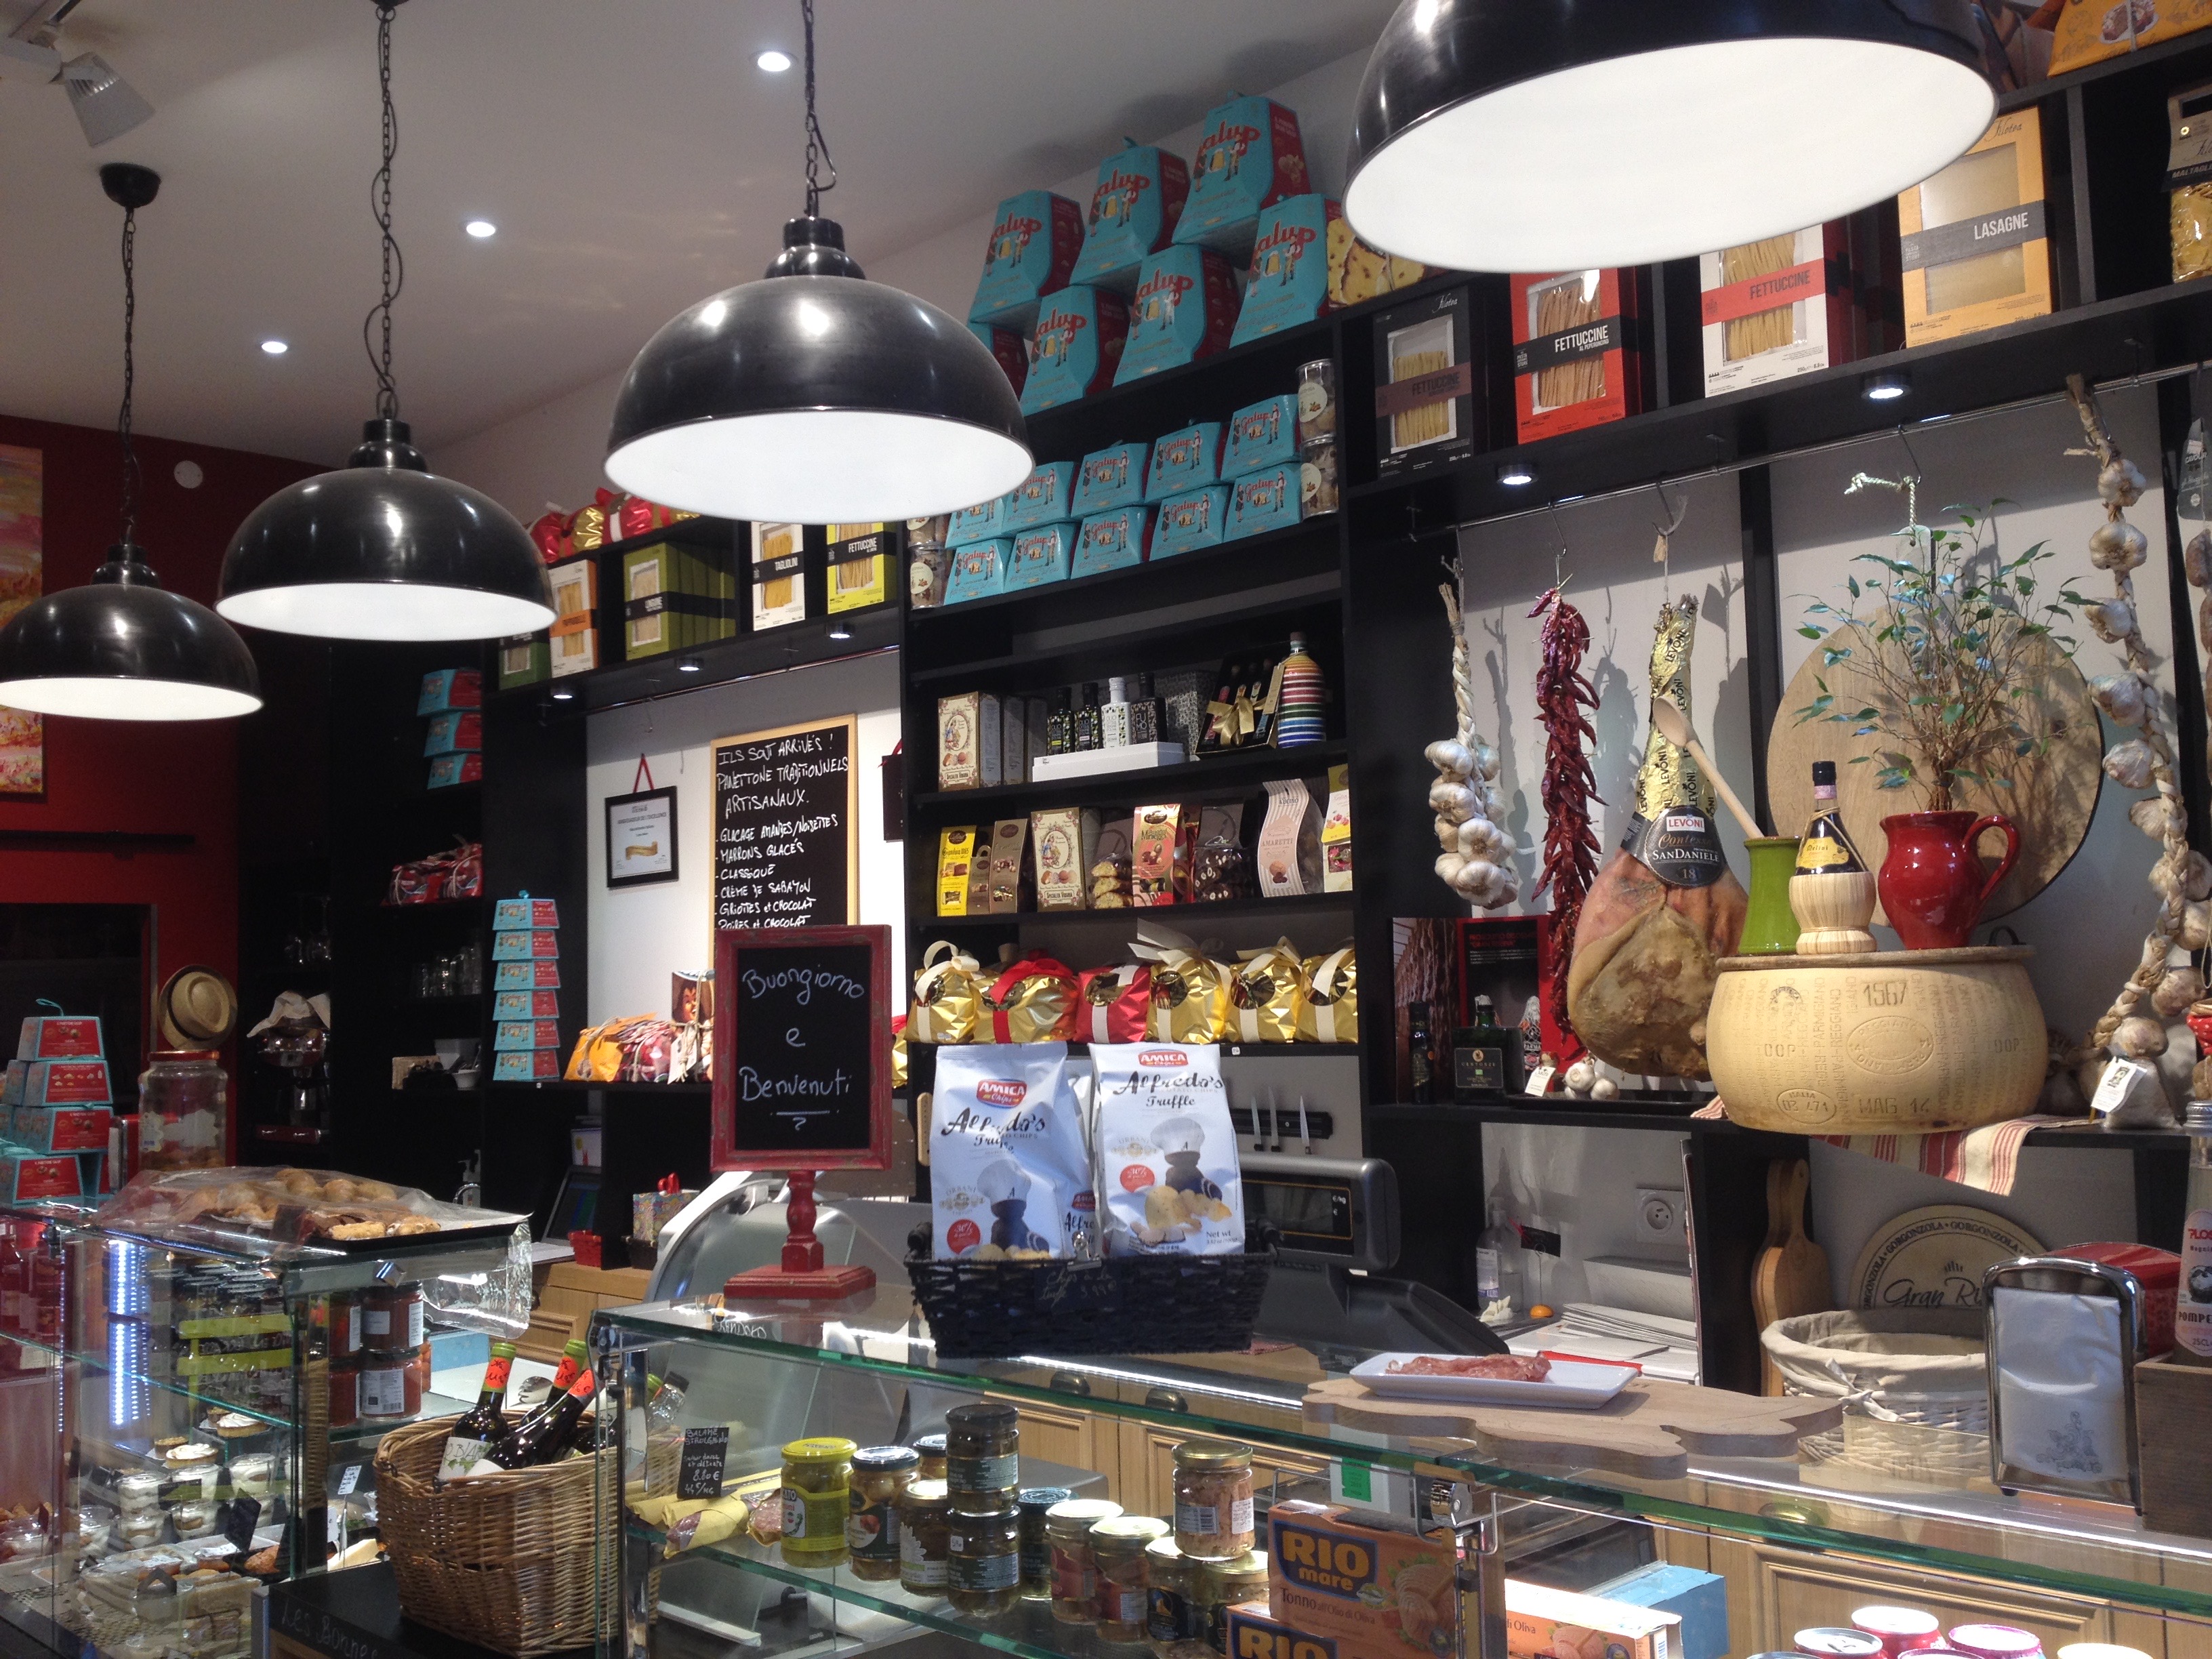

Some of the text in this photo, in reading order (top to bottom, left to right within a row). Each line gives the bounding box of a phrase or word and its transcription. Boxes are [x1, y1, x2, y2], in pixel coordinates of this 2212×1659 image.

[1974, 211, 2028, 240] LASAGNE
[1750, 270, 1810, 300] FETTUCCINE
[1555, 325, 1609, 352] FETTUCCINE
[1412, 371, 1460, 396] FETTUCCINE
[1665, 630, 1687, 662] LEVONI
[1677, 678, 1687, 711] LEVONI
[718, 750, 745, 765] ILS
[1658, 750, 1670, 785] LEVONI
[1639, 779, 1647, 813] LEVONI
[1688, 771, 1697, 806] LEVONI
[1668, 819, 1703, 828] LEVONI
[1261, 838, 1294, 847] AMARETTI
[720, 846, 762, 864] MARRONS
[720, 864, 776, 880] CLASSIQUE
[1682, 868, 1697, 879] 18
[752, 884, 763, 898] DE
[769, 878, 811, 895] SABAYON
[764, 903, 772, 913] et
[773, 897, 817, 912] CHOCOLAT
[764, 916, 811, 928] CHOCOLAT
[742, 964, 864, 1005] Buongiorno
[1864, 982, 1908, 1006] 1567
[786, 1027, 806, 1047] e
[1141, 1054, 1186, 1062] AMICA
[739, 1066, 853, 1101] Benvenuti
[979, 1082, 1025, 1095] AMICA
[1113, 1071, 1224, 1095] Alfredo's
[1146, 1094, 1195, 1109] Truffle
[1886, 1221, 1944, 1254] GORGONZOLA
[1950, 1221, 2018, 1252] GORGONZOLA
[713, 1471, 720, 1481] €
[1282, 1530, 1369, 1578] RIO
[1299, 1567, 1354, 1591] mare
[1280, 1587, 1317, 1610] Tonno
[1345, 1607, 1353, 1619] di
[1353, 1610, 1376, 1624] Oliva
[1514, 1620, 1536, 1634] Oliva
[1239, 1626, 1328, 1659] RIO
